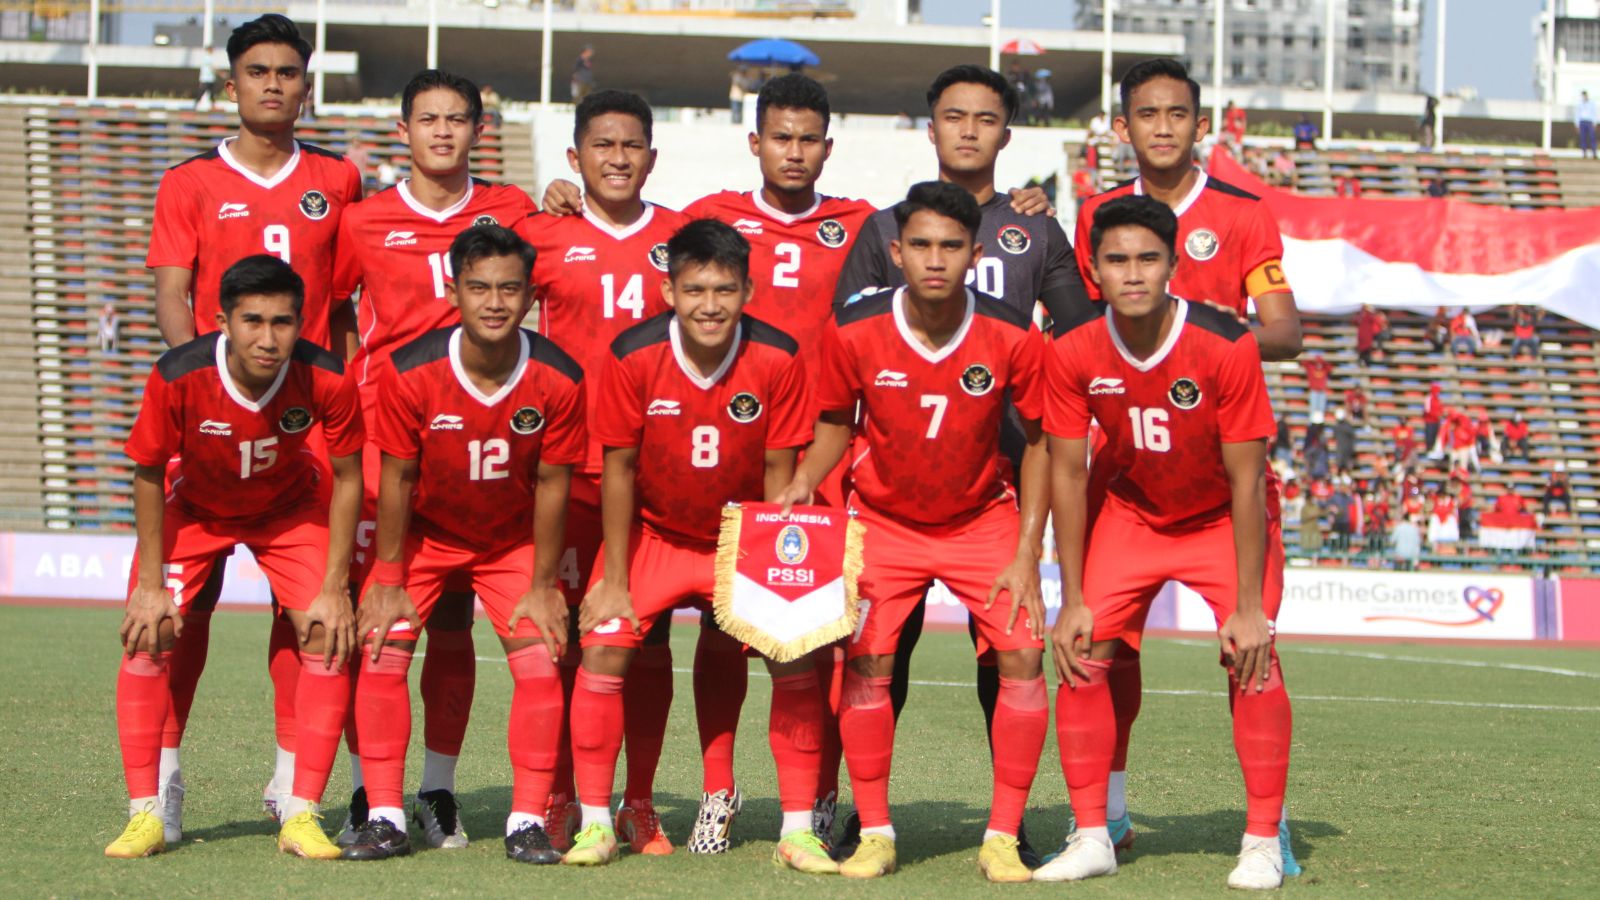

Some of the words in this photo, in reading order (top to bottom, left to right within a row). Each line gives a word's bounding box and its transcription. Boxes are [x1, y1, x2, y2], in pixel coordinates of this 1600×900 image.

[263, 224, 290, 265] 9
[772, 242, 801, 288] 2
[600, 273, 645, 319] 14
[1263, 264, 1286, 285] C
[920, 394, 949, 439] 7
[1127, 406, 1171, 453] 16
[239, 436, 279, 479] 15
[467, 438, 510, 480] 12
[691, 425, 720, 468] 8
[34, 553, 104, 578] ABA
[767, 567, 814, 584] PSSI
